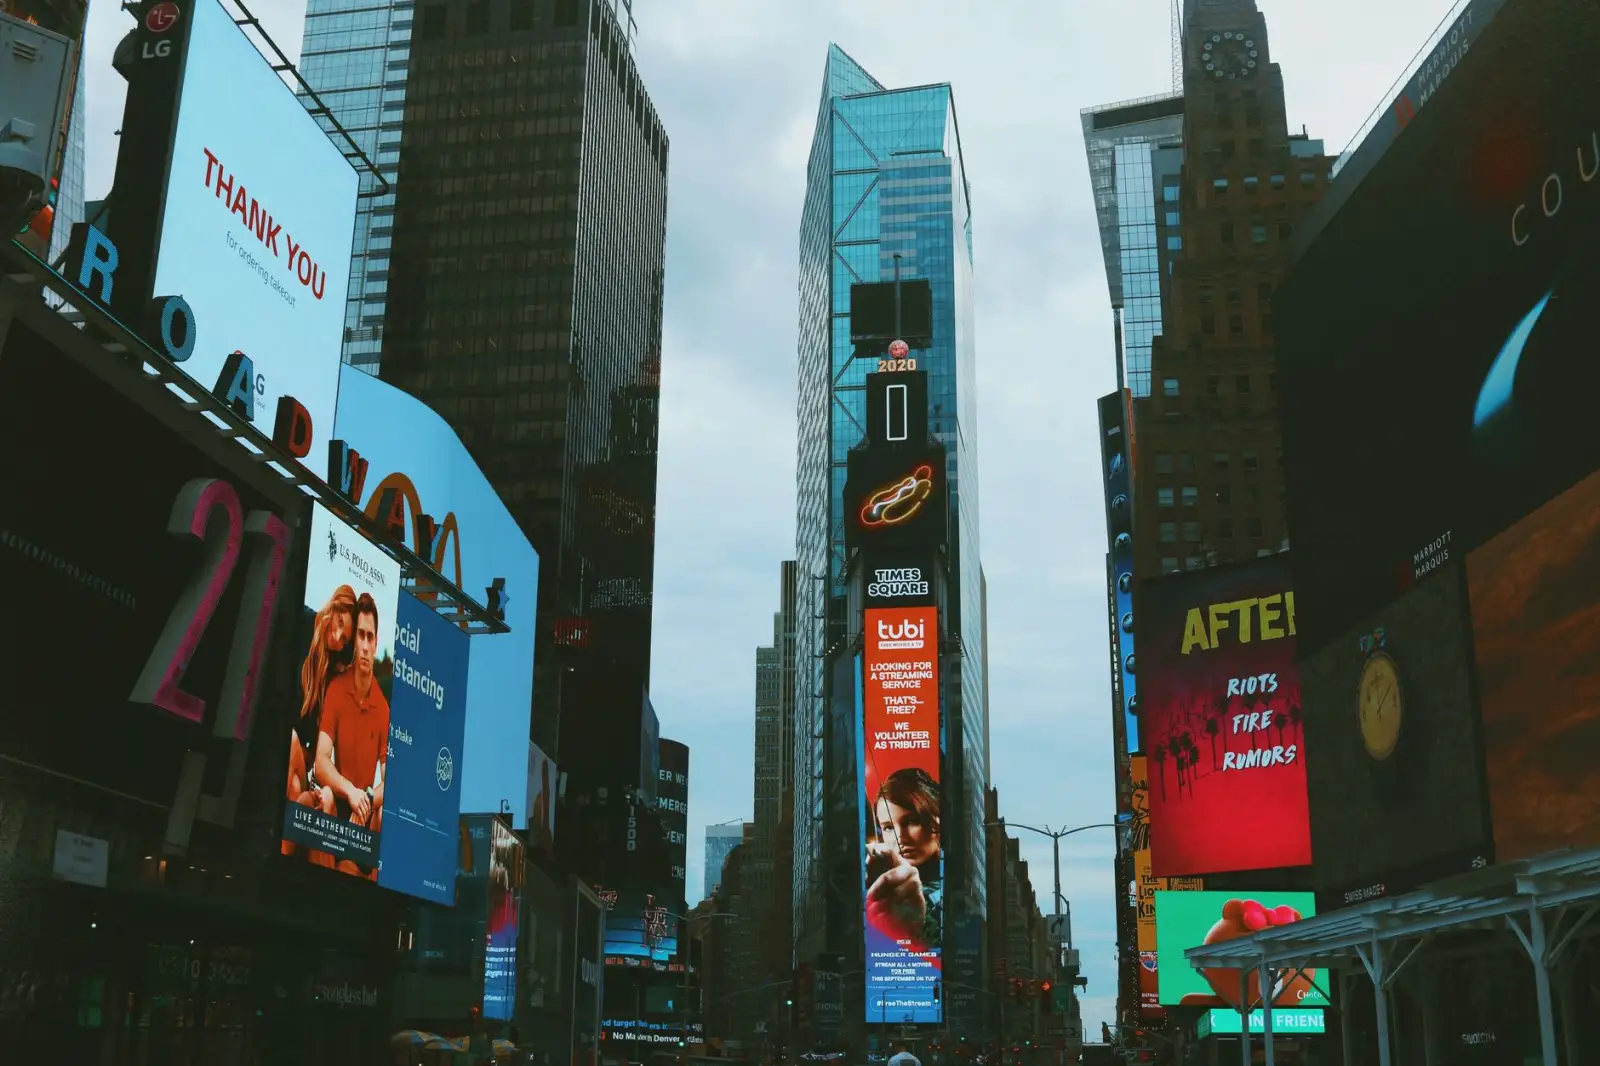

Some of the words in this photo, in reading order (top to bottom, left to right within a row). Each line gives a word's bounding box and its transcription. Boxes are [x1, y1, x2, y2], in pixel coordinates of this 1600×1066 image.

[142, 39, 172, 59] LG
[1417, 10, 1474, 88] MARRIOTT
[1420, 38, 1469, 107] MARQUIS
[203, 147, 282, 257] THANK
[287, 233, 326, 300] YOU
[226, 230, 239, 251] for
[238, 247, 269, 285] ordering
[270, 276, 296, 308] takeout
[878, 358, 917, 373] 2020
[1413, 530, 1452, 565] MARRIOTT
[339, 543, 351, 562] U.S.
[351, 552, 369, 573] POLO
[369, 566, 386, 586] ASSN.
[1415, 549, 1449, 579] MARQUIS
[875, 568, 922, 582] TIMES
[868, 581, 929, 597] SQUARE
[130, 478, 293, 742] 21
[877, 618, 925, 640] tubi
[870, 662, 912, 671] LOOKING
[913, 661, 932, 670] FOR
[870, 672, 878, 680] A
[879, 671, 933, 680] STREAMING
[882, 680, 921, 689] SERVICE
[1226, 673, 1278, 698] RIOTS
[886, 705, 916, 715] FREE?
[894, 722, 909, 730] WE
[1232, 709, 1274, 735] FIRE
[394, 725, 413, 746] shake
[873, 741, 887, 750] AS
[889, 740, 930, 749] TRIBUTE!
[874, 731, 929, 740] VOLUNTEER
[1222, 744, 1297, 772] RUMORS
[295, 809, 312, 823] LIVE
[315, 817, 372, 844] AUTHENTICALLY
[626, 804, 637, 851] 1500
[1141, 875, 1160, 884] THE
[1139, 885, 1162, 900] LIO
[1344, 888, 1363, 903] SWISS
[1363, 884, 1381, 898] MADE
[613, 1019, 635, 1028] target
[653, 1035, 680, 1043] Denver
